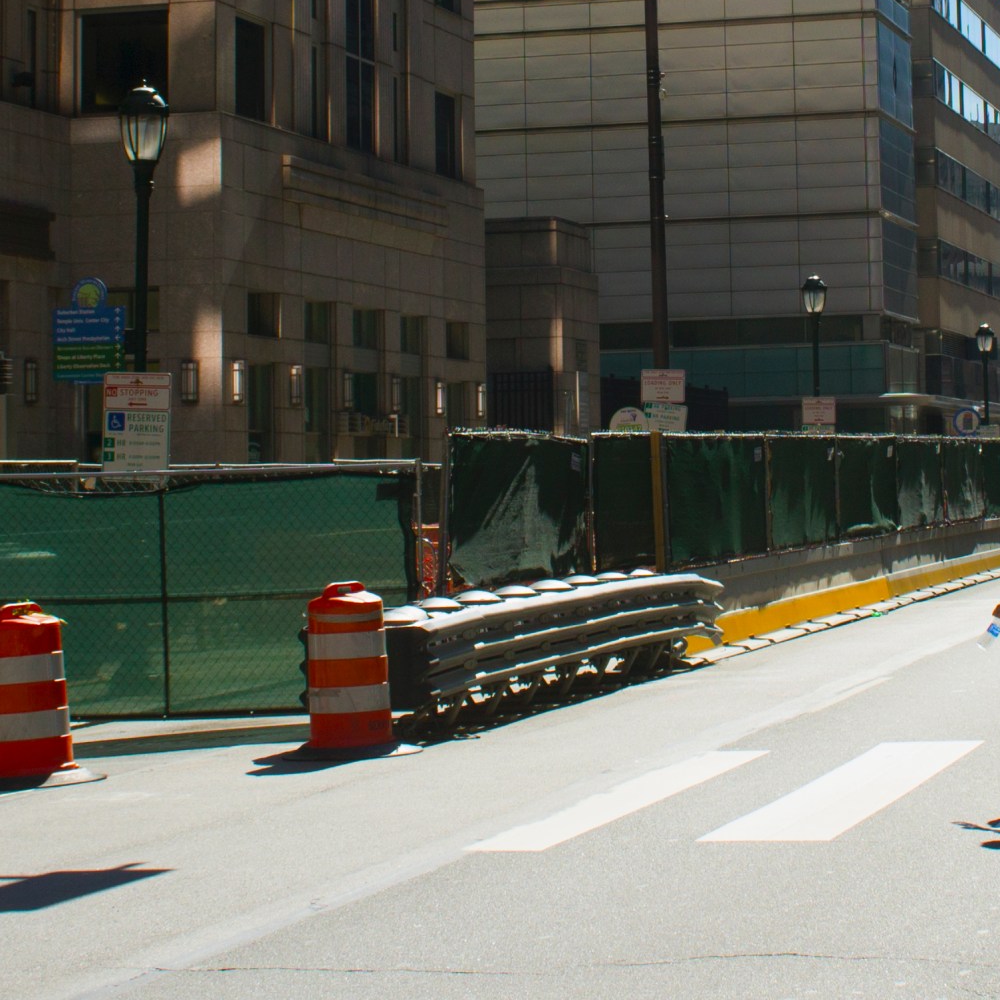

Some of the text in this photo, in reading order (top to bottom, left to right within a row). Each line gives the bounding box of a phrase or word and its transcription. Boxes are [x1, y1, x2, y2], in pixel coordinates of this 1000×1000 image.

[106, 388, 159, 397] NO STOPPING
[127, 413, 167, 422] RESERVED
[128, 424, 165, 433] PARKING
